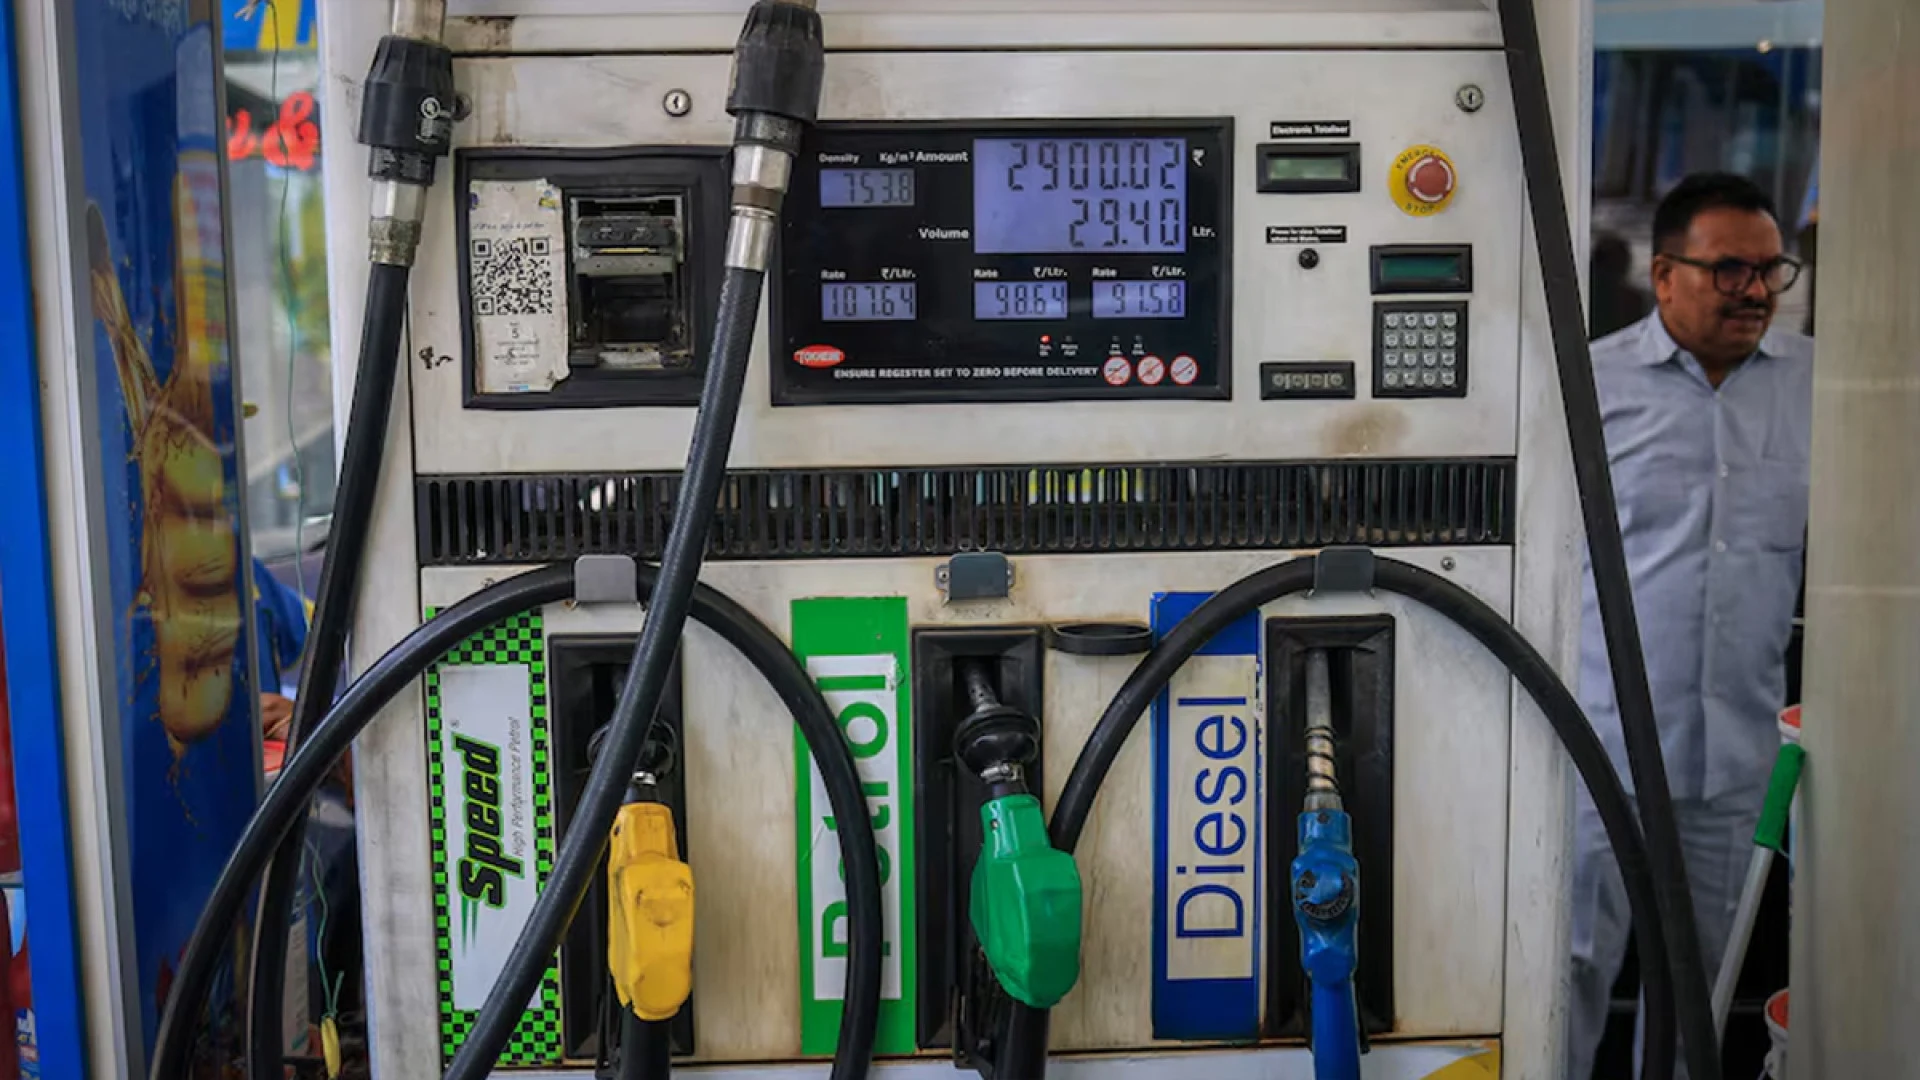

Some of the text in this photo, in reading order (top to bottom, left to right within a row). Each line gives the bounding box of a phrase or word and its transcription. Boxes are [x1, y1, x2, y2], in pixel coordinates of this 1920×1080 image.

[819, 153, 860, 164] Density
[916, 151, 968, 163] Amount
[1008, 142, 1180, 190] 2900.02
[843, 172, 913, 204] 753.8
[918, 228, 969, 240] Volume
[1069, 199, 1180, 246] 29.40
[1192, 225, 1216, 238] Ltr.
[821, 270, 846, 279] Rate
[974, 269, 998, 278] Rate
[1092, 268, 1117, 277] Rate
[832, 286, 914, 316] 107.64
[996, 284, 1065, 315] 98.64
[1112, 282, 1182, 314] 91.58
[834, 366, 1098, 379] ENSURE REGISTER SET TO ZERO BEFORE DELIVERY
[509, 755, 527, 829] Performance
[451, 733, 525, 909] Speed
[1176, 697, 1247, 938] Diesel
